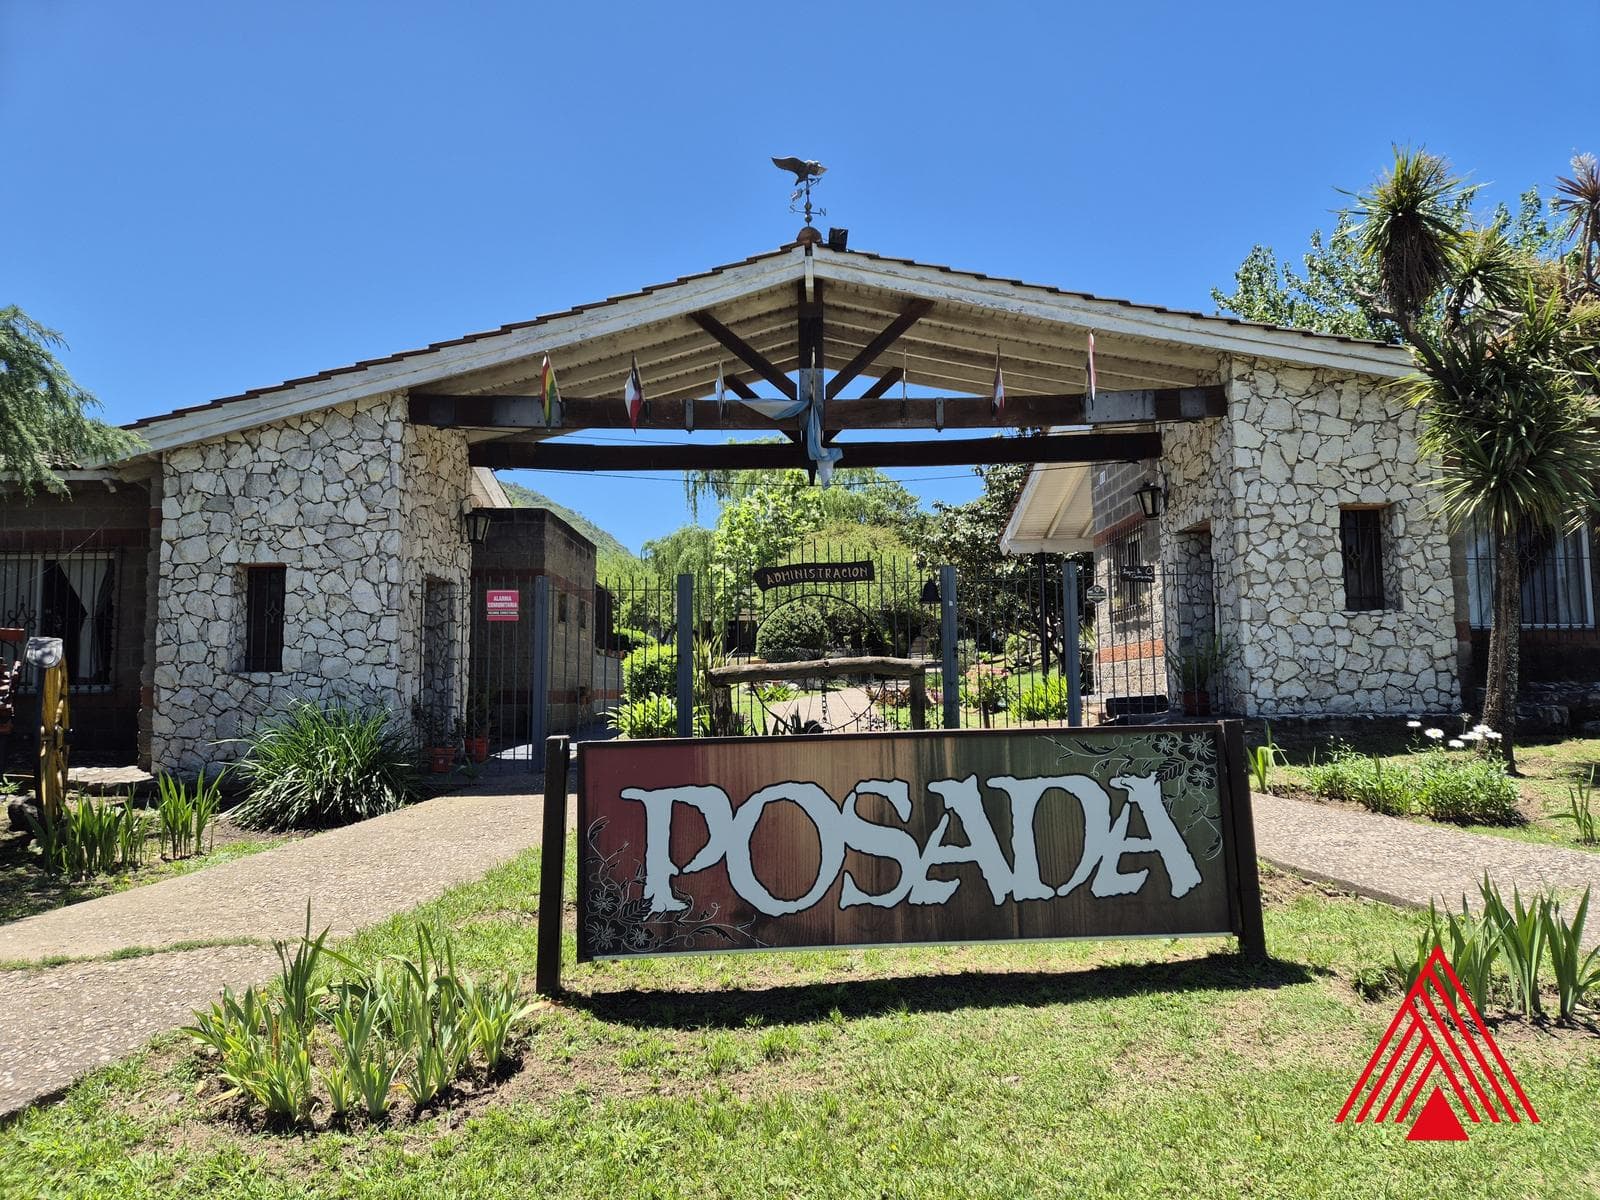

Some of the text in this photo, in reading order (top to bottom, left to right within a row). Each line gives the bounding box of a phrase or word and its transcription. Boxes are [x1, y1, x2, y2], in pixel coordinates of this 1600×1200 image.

[819, 207, 827, 217] N
[766, 566, 869, 586] ADMINISTRACION
[620, 773, 1203, 919] POSADA
